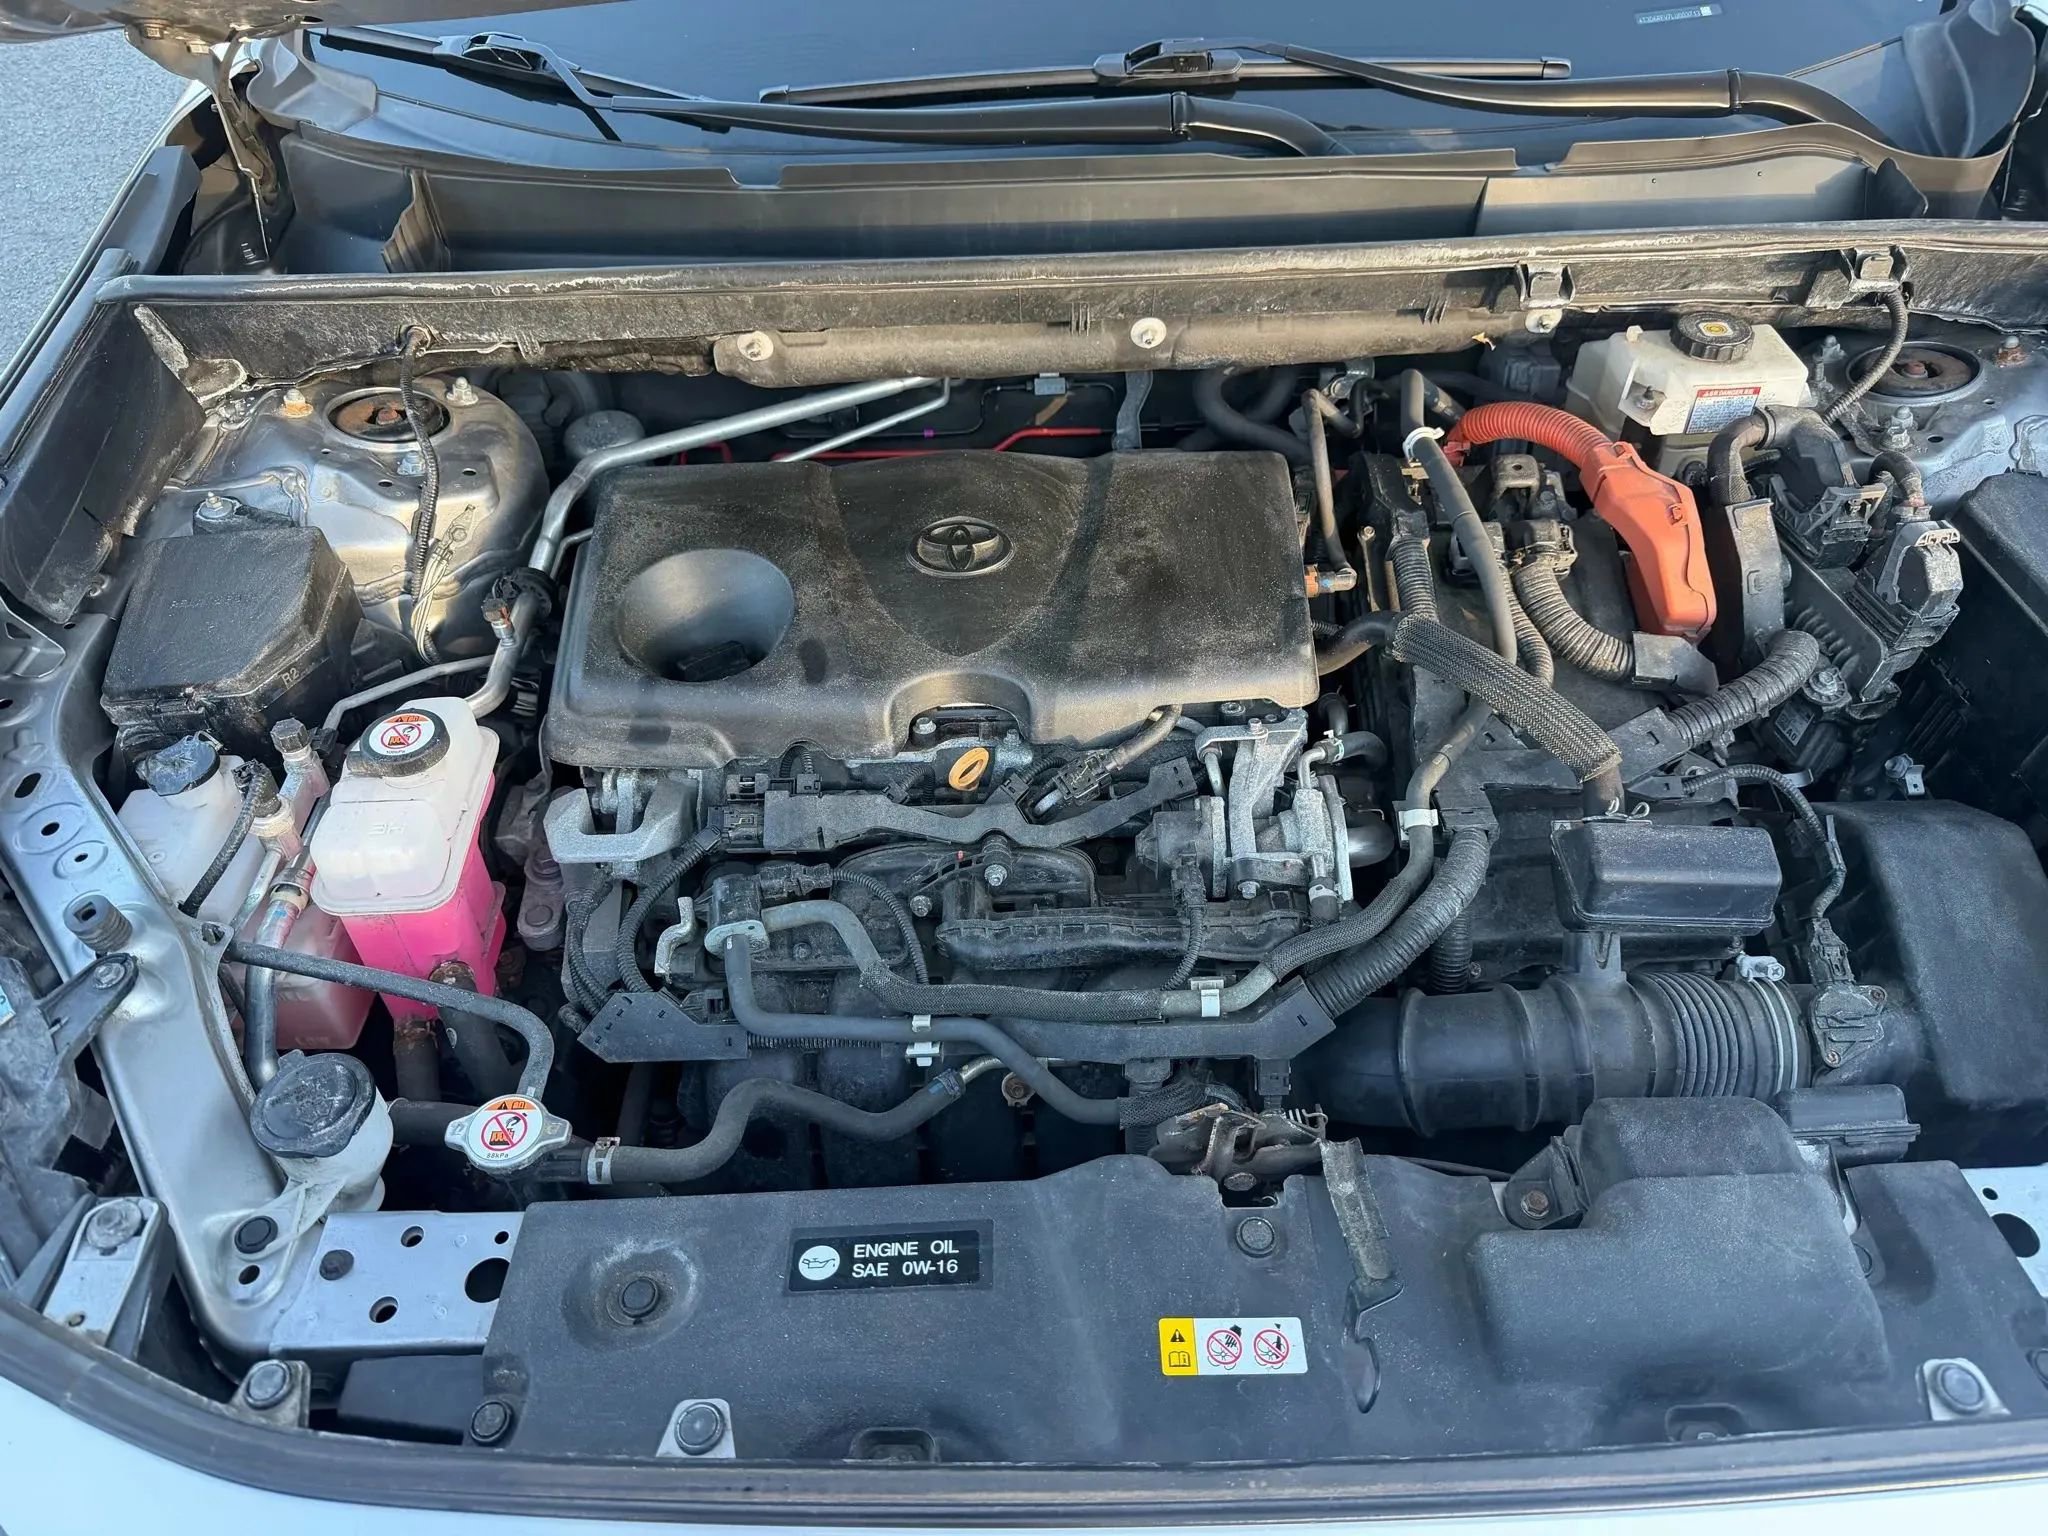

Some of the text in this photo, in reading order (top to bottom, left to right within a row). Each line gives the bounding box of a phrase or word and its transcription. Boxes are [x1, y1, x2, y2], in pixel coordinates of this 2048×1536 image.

[853, 1240, 960, 1258] ENGINE OIL
[852, 1259, 959, 1278] SAE 0W-16
